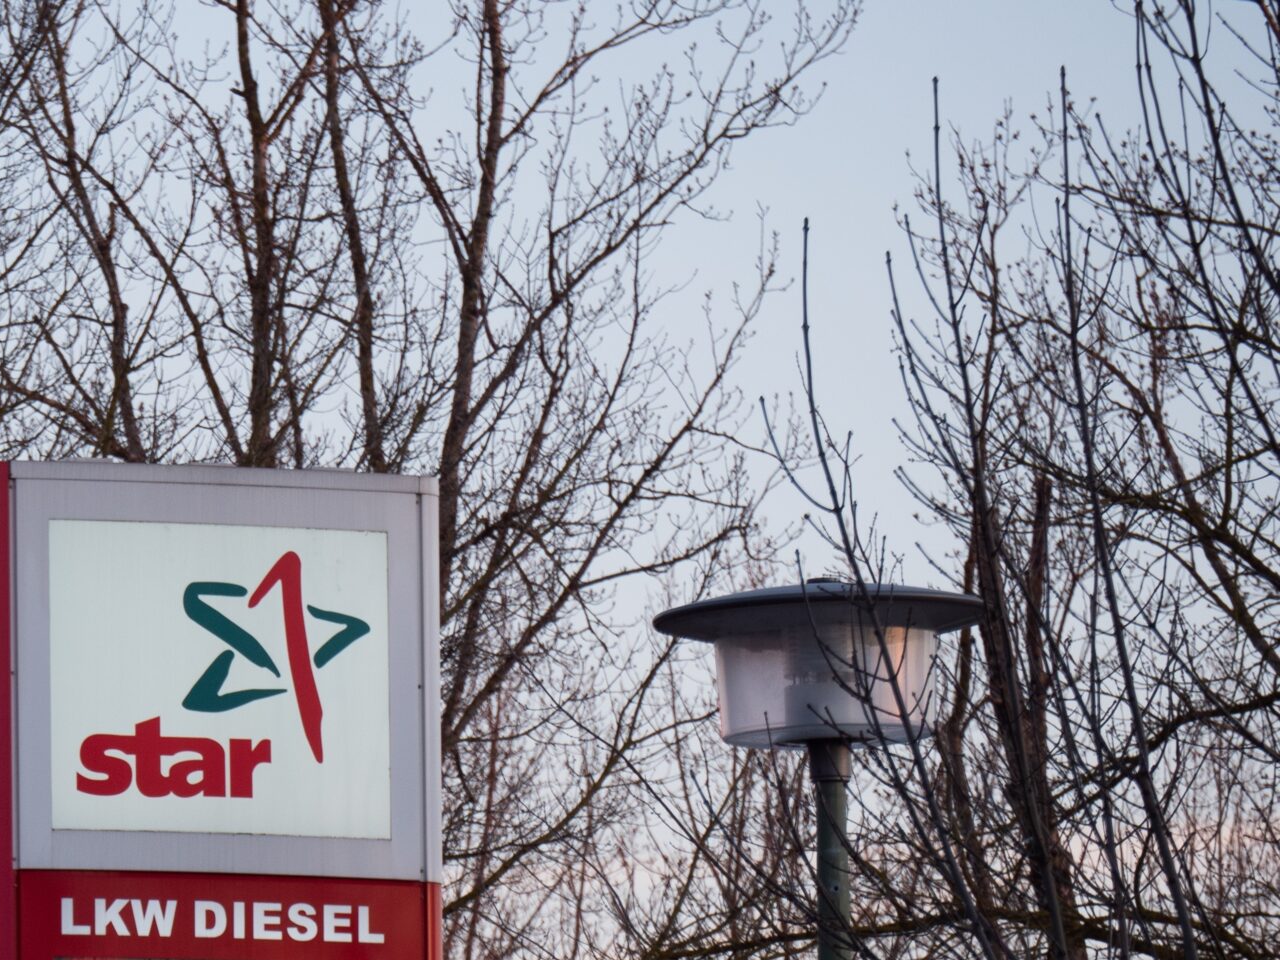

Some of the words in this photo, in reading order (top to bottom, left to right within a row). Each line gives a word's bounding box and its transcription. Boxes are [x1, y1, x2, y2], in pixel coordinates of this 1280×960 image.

[76, 717, 272, 799] star
[61, 897, 178, 938] LKW
[194, 900, 385, 944] DIESEL
